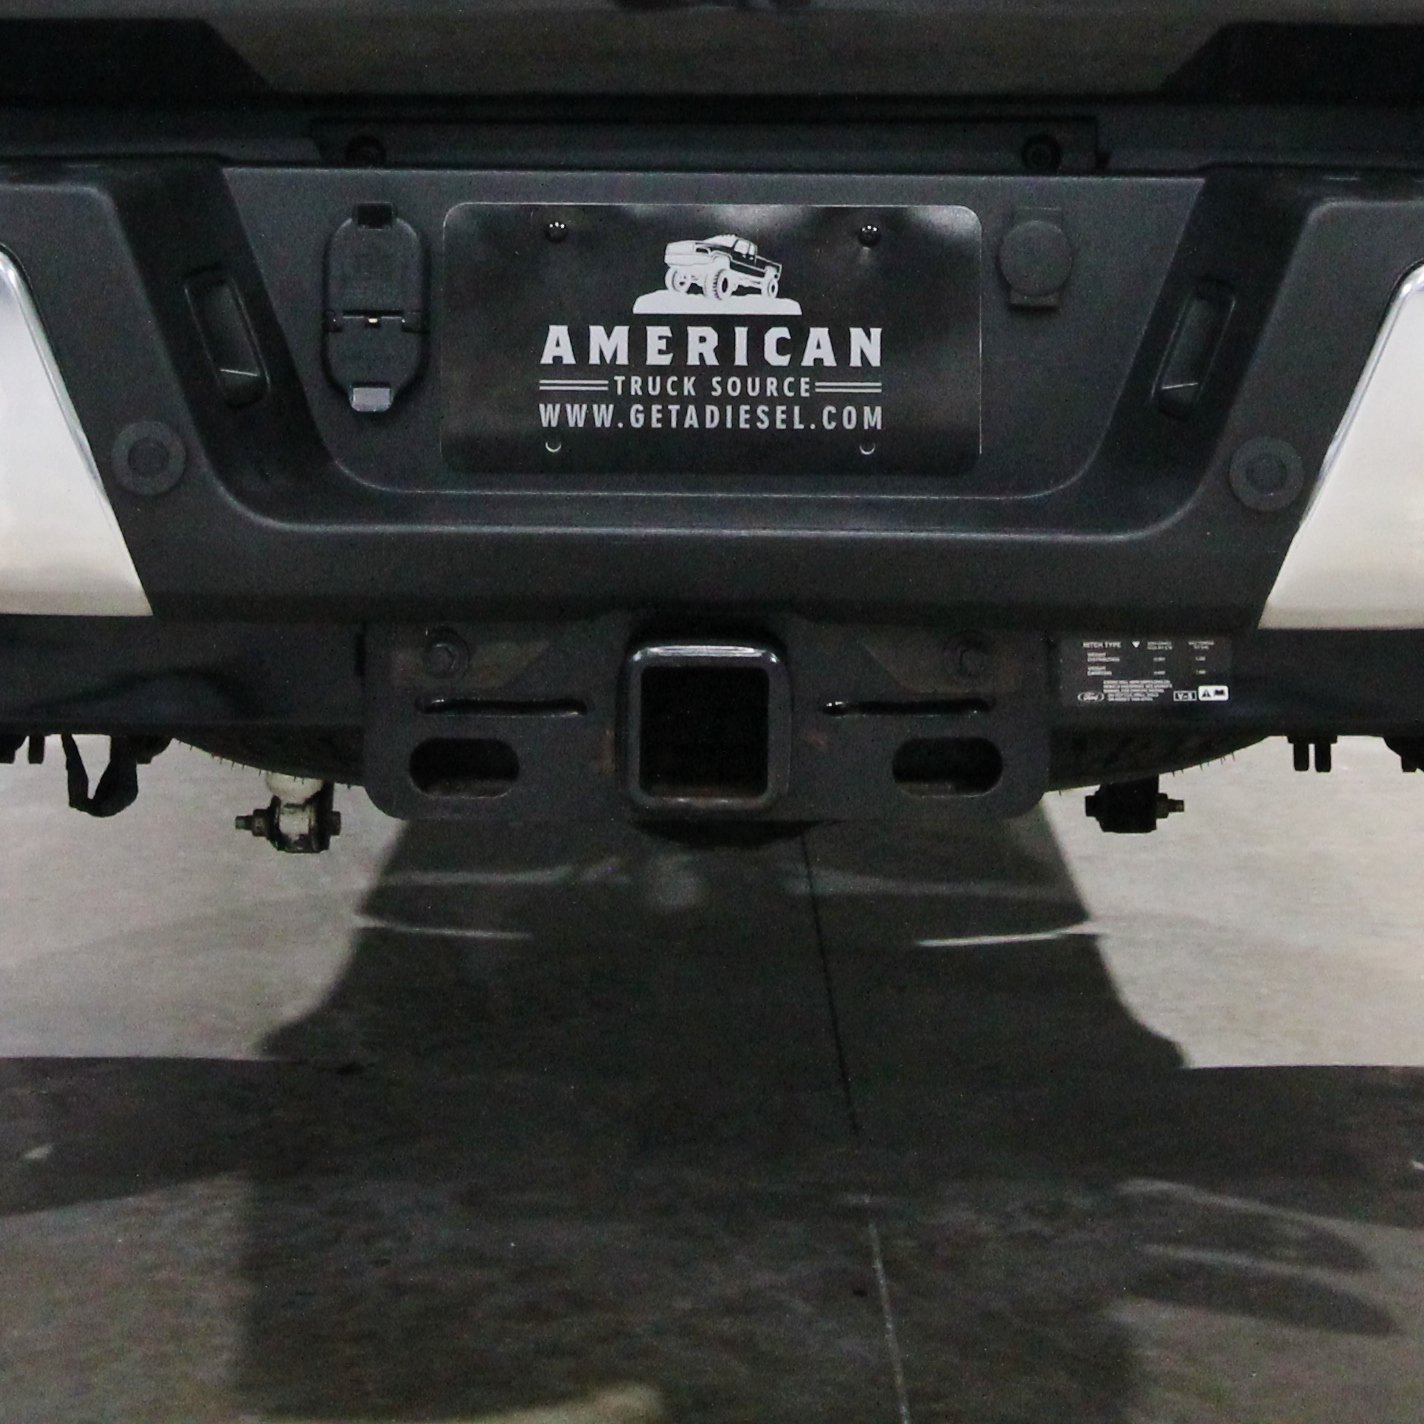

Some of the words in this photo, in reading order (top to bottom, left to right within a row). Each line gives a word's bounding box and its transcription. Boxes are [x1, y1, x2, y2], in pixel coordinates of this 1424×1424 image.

[539, 324, 883, 368] AMERICAN
[613, 375, 697, 397] TRUCK
[711, 377, 811, 398] SOURCE
[538, 403, 883, 431] WWW.GETADIESEL.COM
